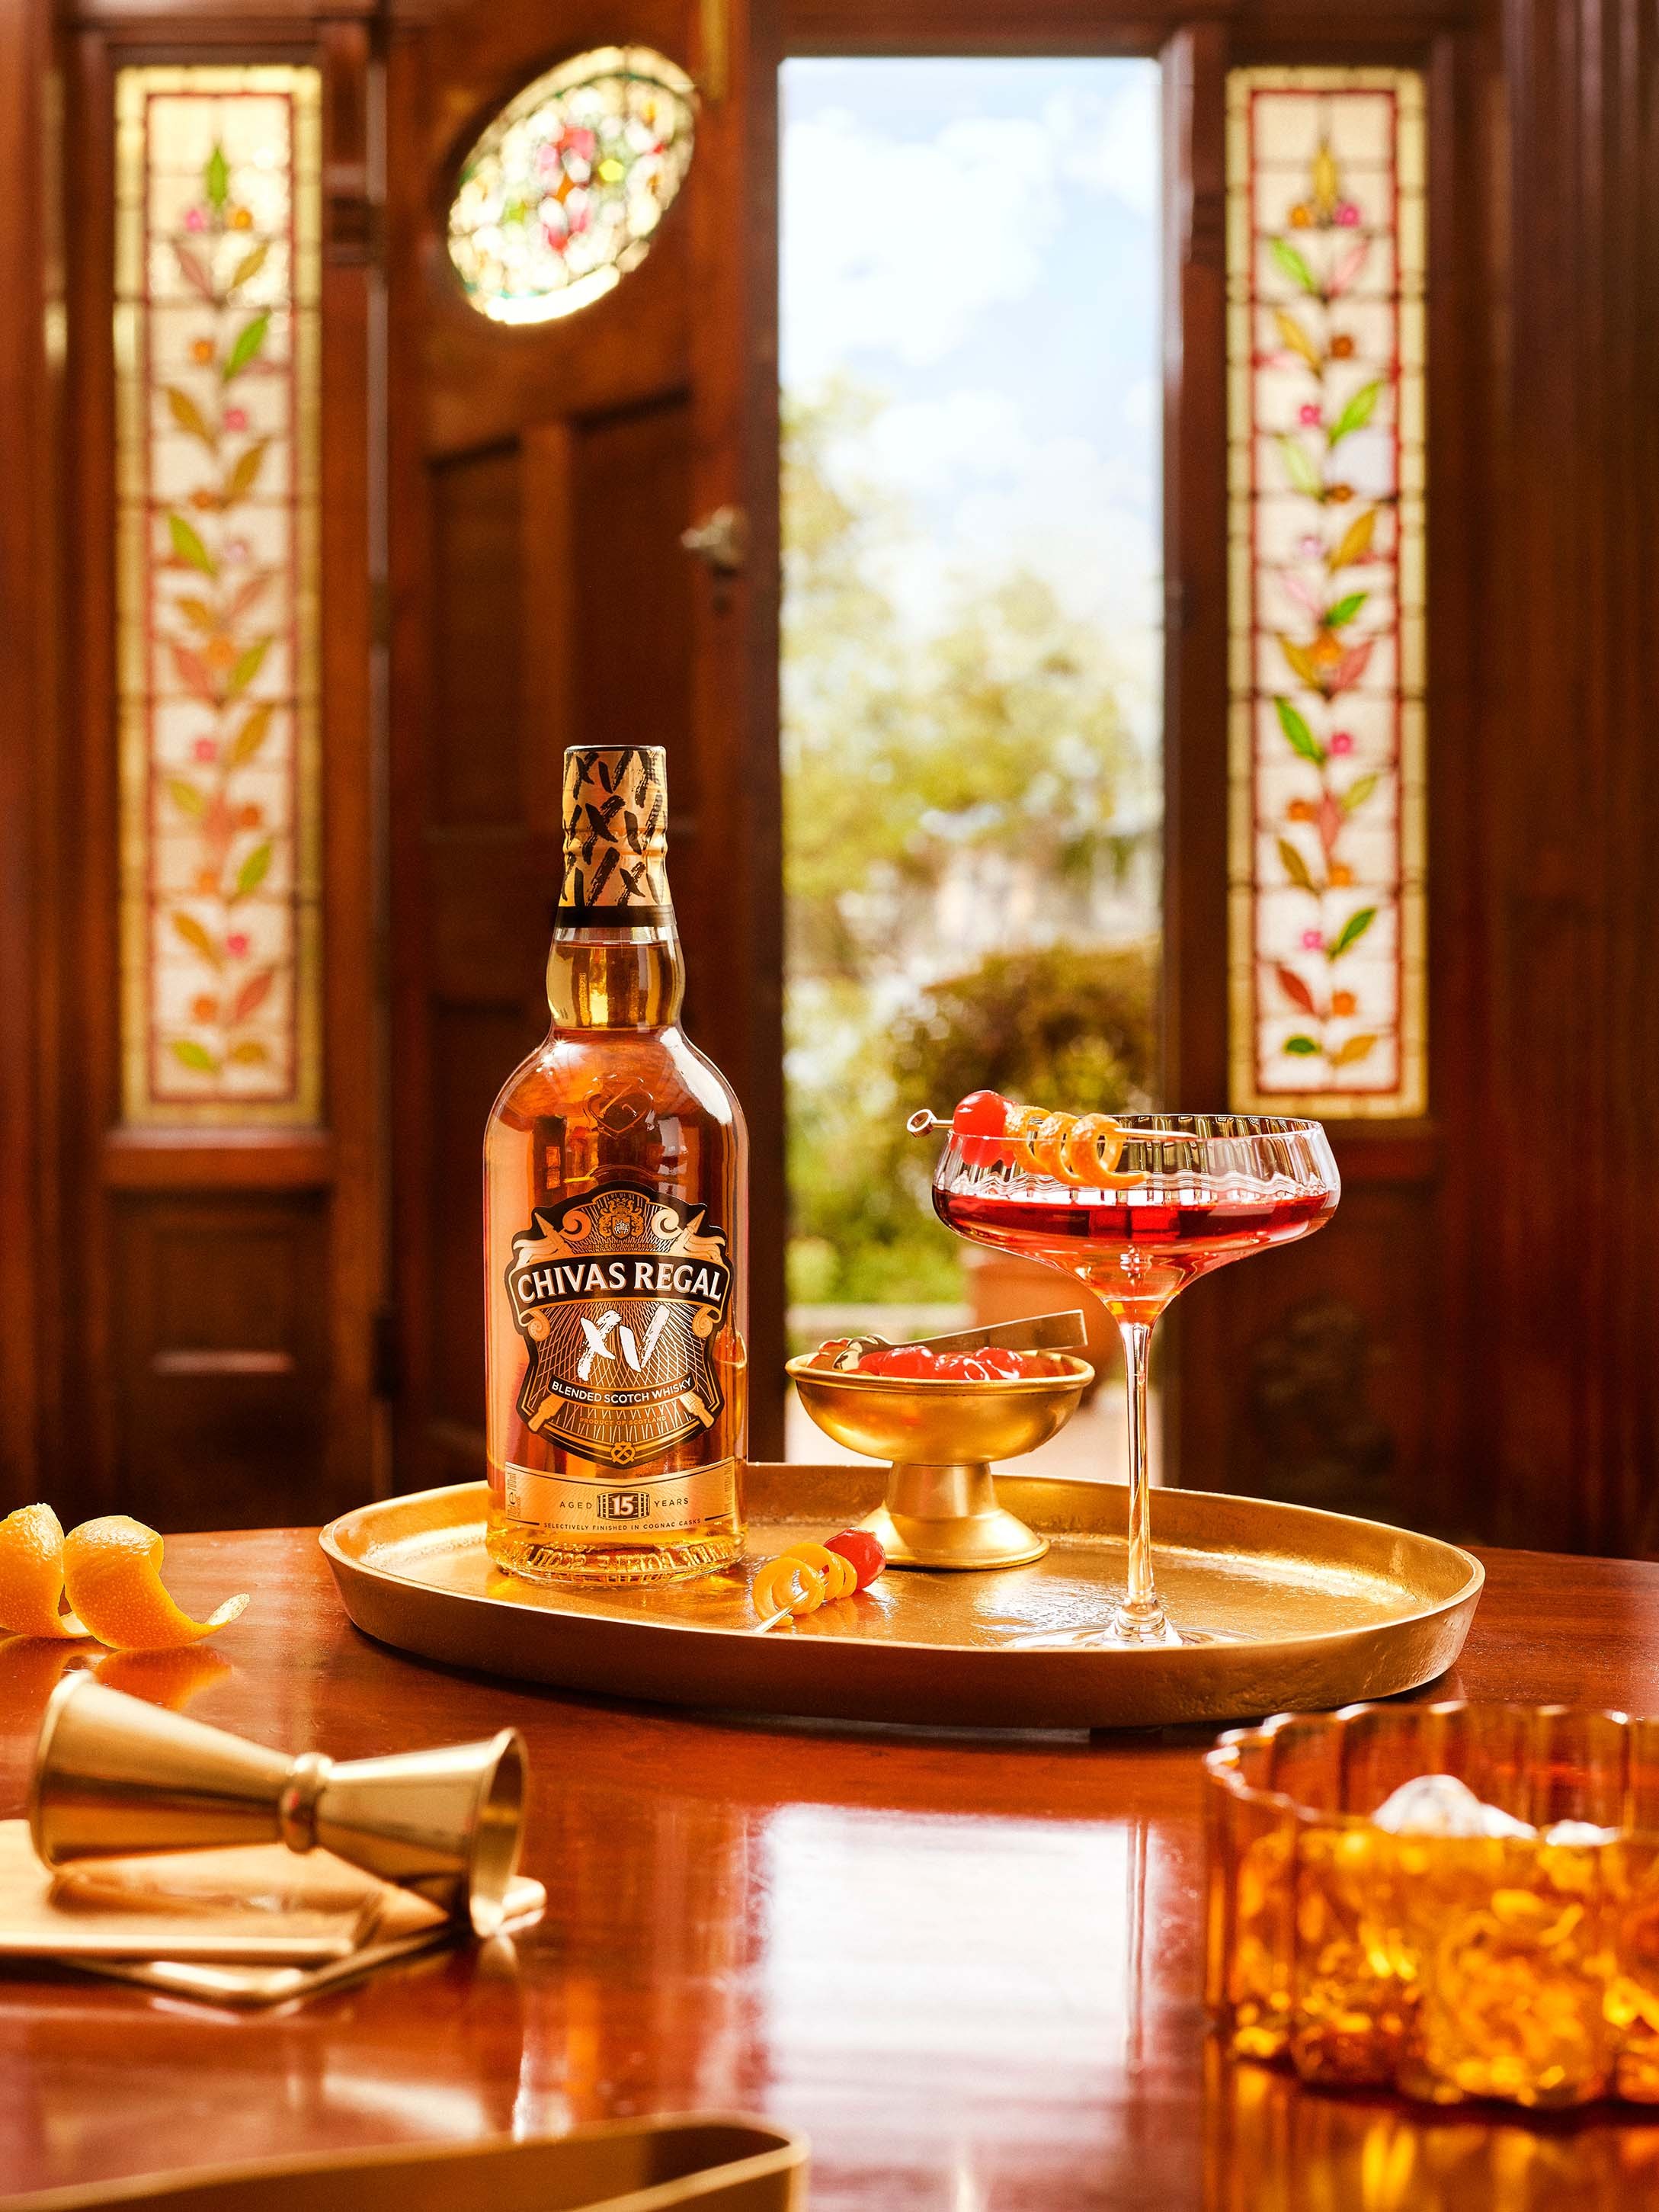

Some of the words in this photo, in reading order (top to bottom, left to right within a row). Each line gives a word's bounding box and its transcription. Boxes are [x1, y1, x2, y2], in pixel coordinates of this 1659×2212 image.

[517, 1262, 626, 1303] CHIVAS
[634, 1262, 722, 1302] REGAL
[577, 1304, 671, 1382] XV
[552, 1381, 602, 1403] BLENDED
[604, 1393, 649, 1404] SCOTCH
[652, 1377, 692, 1399] WHISKY
[579, 1417, 614, 1425] PRODUCT
[629, 1415, 667, 1425] SCOTLAND
[559, 1501, 593, 1509] AGED
[611, 1495, 636, 1516] 15
[654, 1497, 689, 1508] YEARS
[543, 1522, 589, 1531] SELECTIVELY
[643, 1521, 675, 1530] COGNAC
[678, 1518, 701, 1526] CASKS
